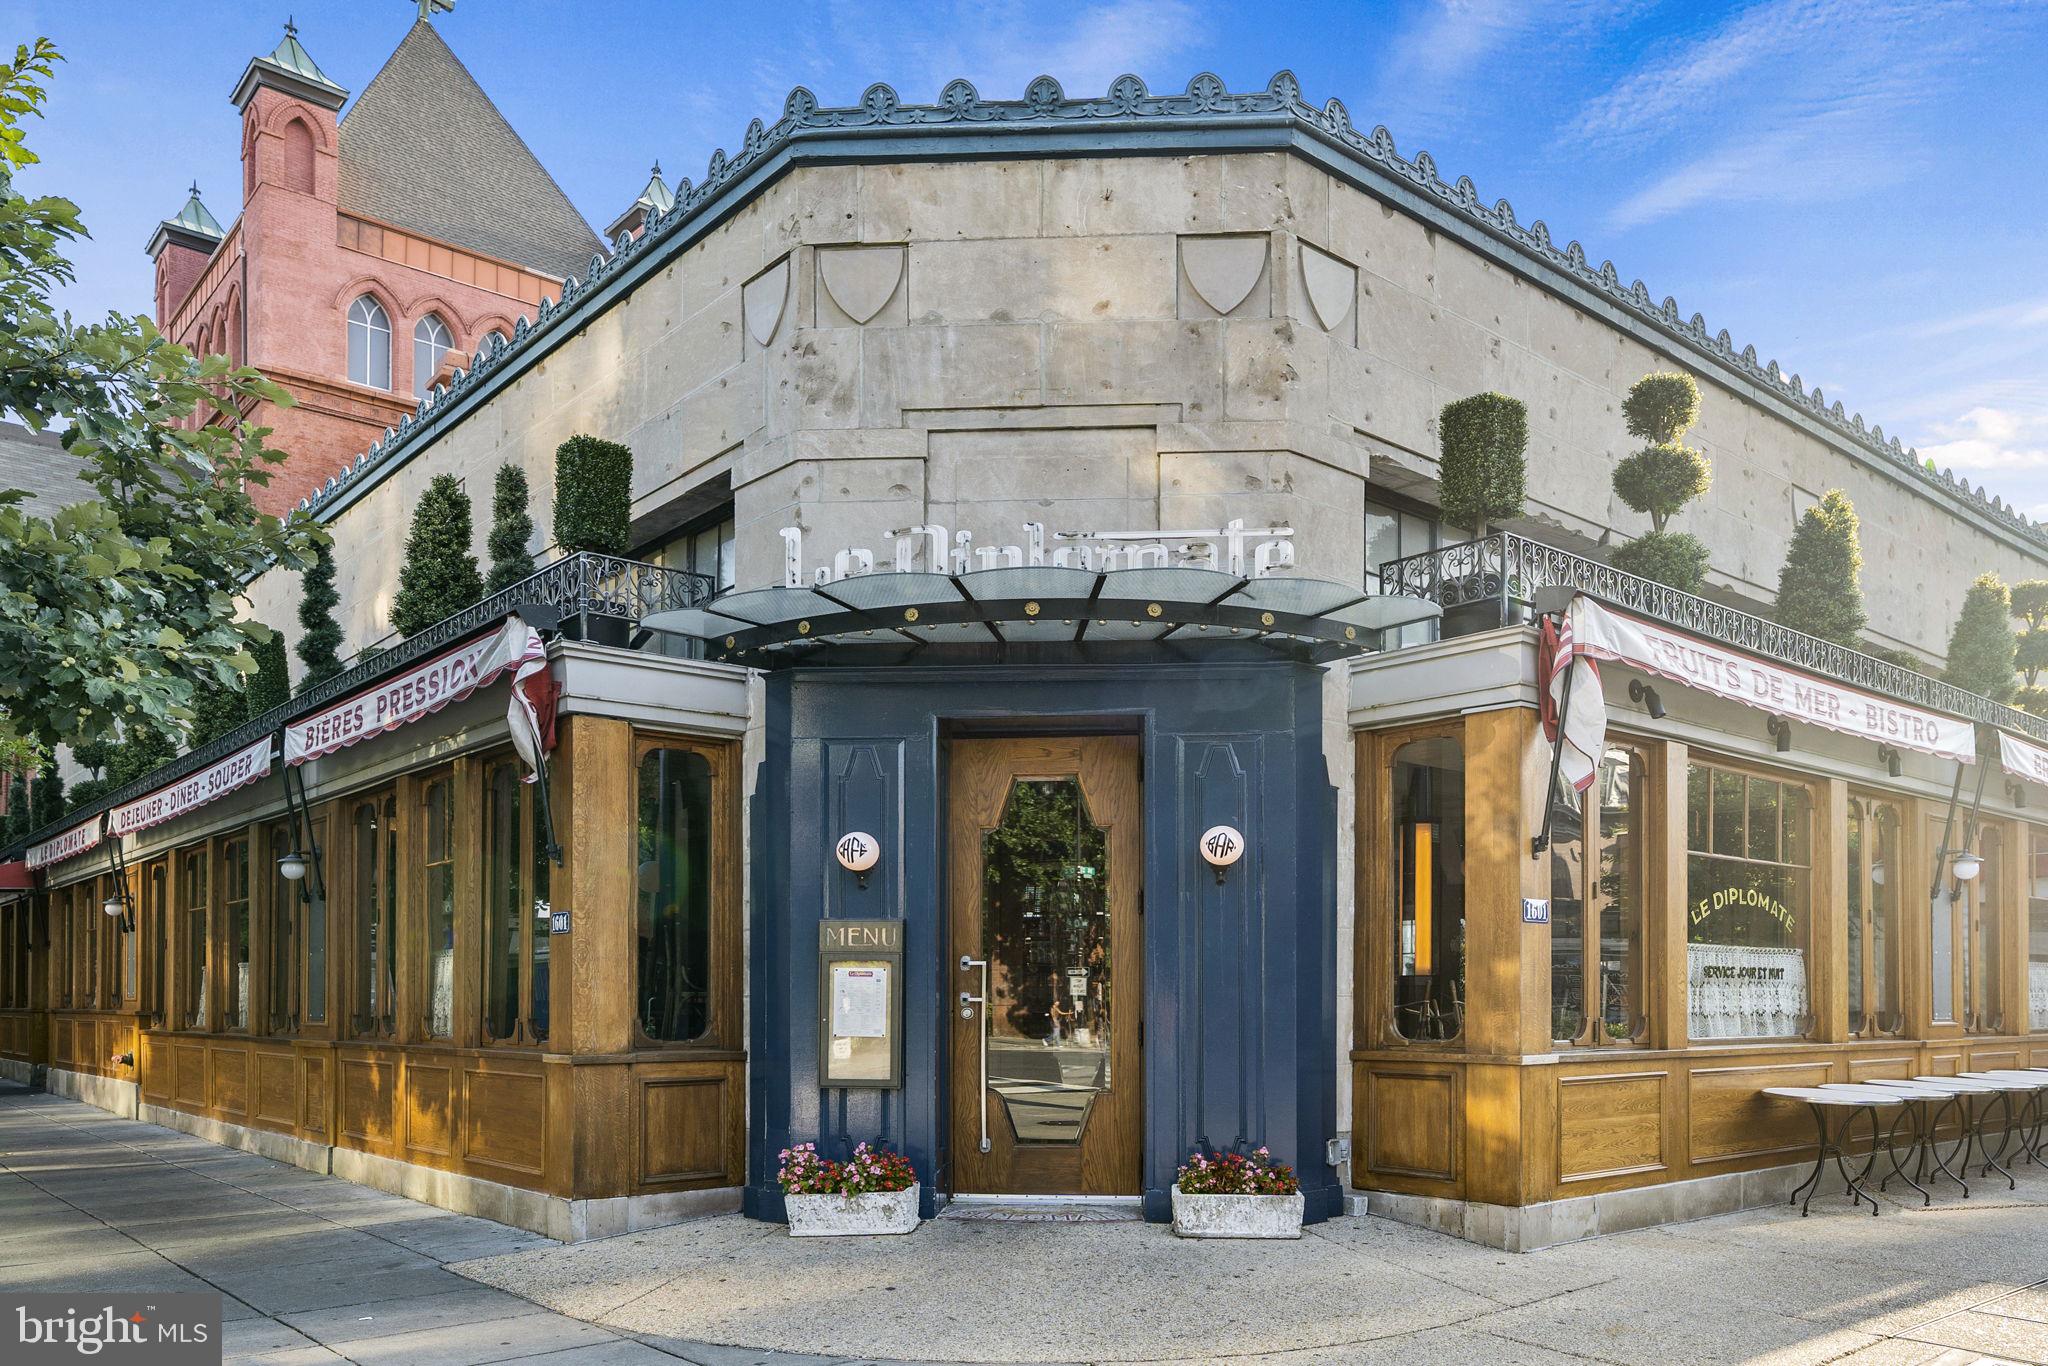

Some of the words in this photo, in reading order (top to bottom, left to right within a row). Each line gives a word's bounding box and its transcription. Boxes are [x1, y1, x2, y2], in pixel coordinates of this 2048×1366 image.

[304, 704, 364, 751] BIÈRES
[376, 648, 483, 723] PRESSION
[1645, 635, 1741, 689] FRUITS
[1751, 669, 1785, 703] DE
[1794, 682, 1841, 721] MER
[1865, 703, 1939, 745] BISTRO
[208, 754, 252, 794] SOUPER
[49, 828, 86, 859] DIPLOMATE
[552, 914, 568, 931] 1601
[1526, 902, 1548, 920] 1601
[1690, 898, 1711, 925] LE
[1712, 887, 1796, 933] DIPLOMATE
[826, 926, 896, 947] MENU
[1703, 965, 1736, 979] SERVICE
[1737, 966, 1757, 979] JOUR
[1757, 966, 1768, 980] ET
[1768, 967, 1785, 980] NUIT
